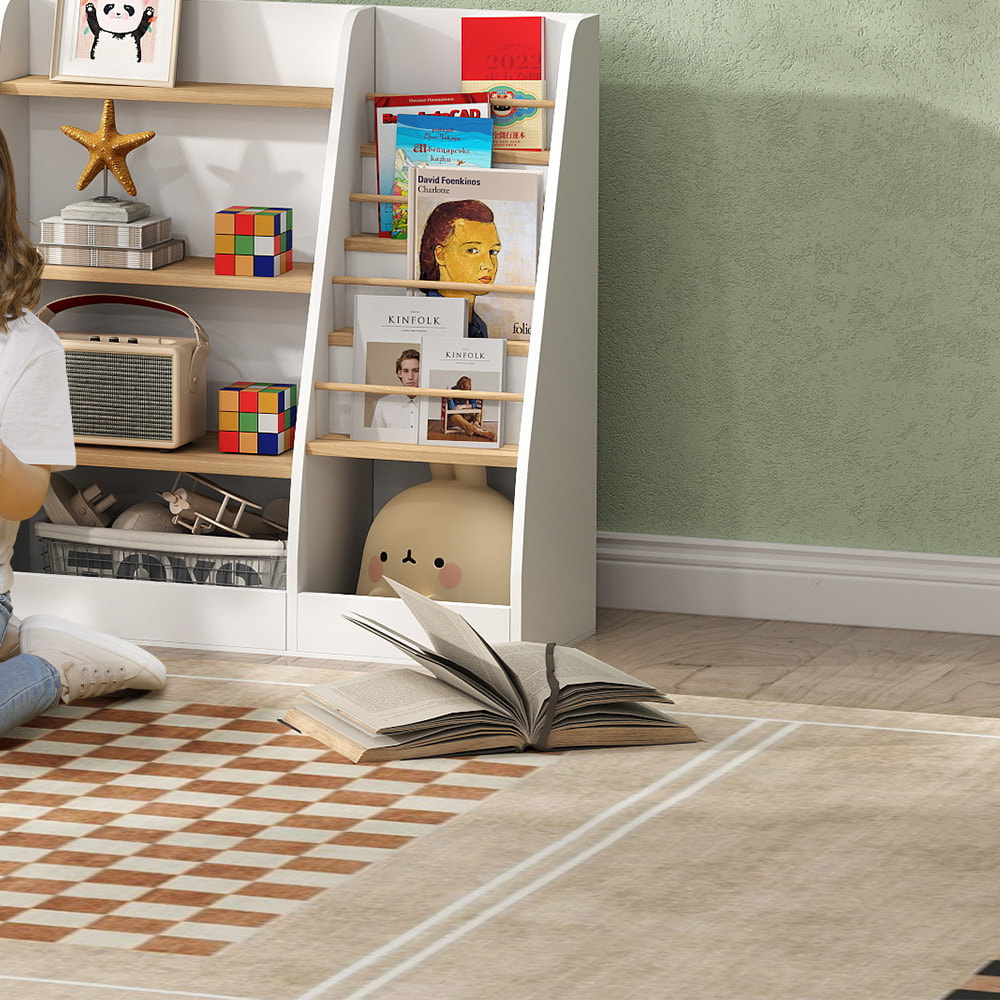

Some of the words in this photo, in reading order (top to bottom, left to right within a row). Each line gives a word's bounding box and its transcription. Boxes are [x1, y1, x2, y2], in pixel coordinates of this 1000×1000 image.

[486, 54, 541, 70] 2022
[417, 175, 440, 184] David
[441, 176, 481, 186] Foenkinos
[417, 185, 450, 195] Charlotte
[388, 315, 441, 326] KINFOLK
[445, 351, 486, 360] KINFOLK
